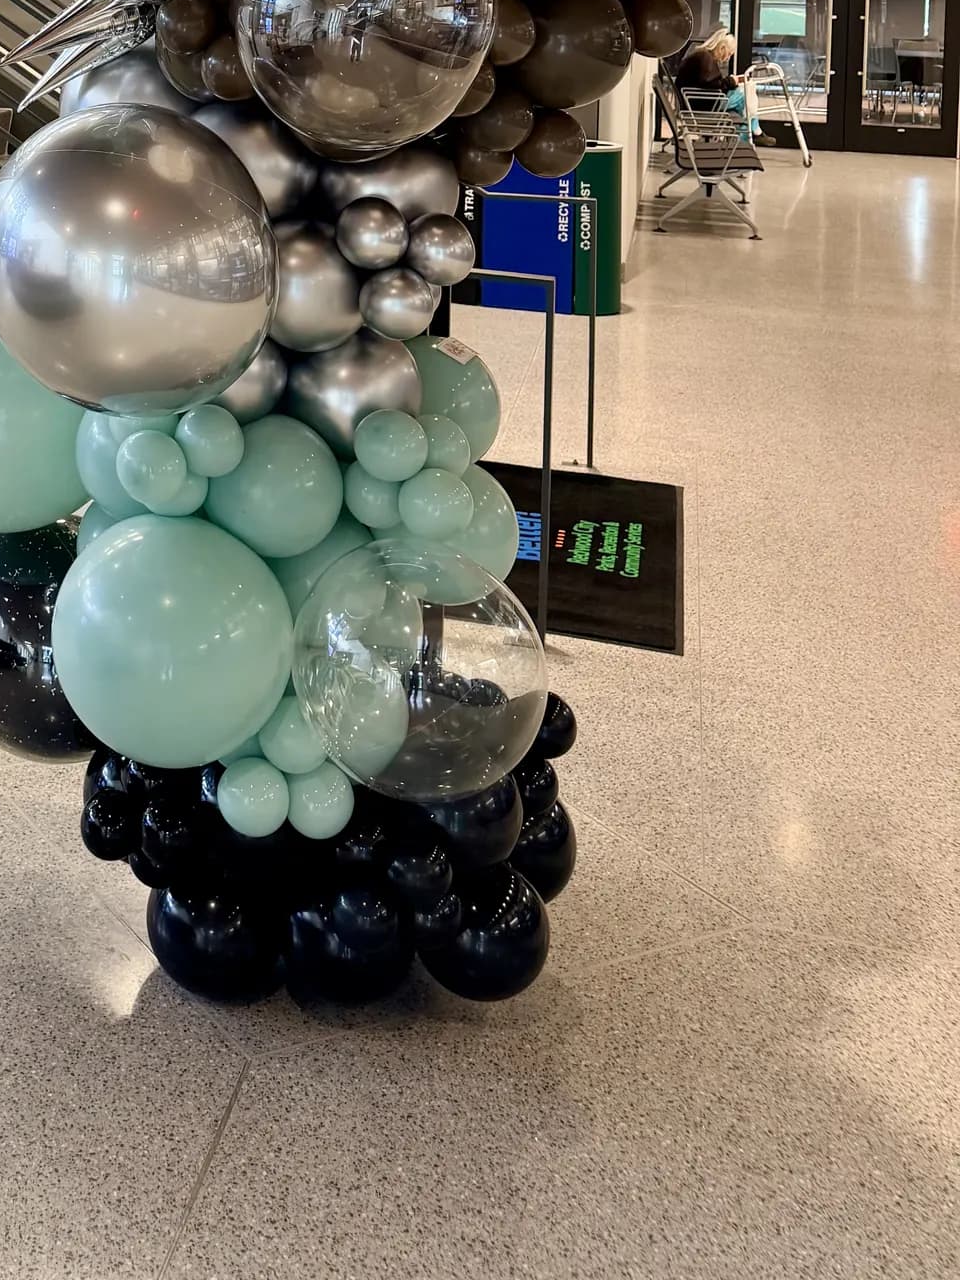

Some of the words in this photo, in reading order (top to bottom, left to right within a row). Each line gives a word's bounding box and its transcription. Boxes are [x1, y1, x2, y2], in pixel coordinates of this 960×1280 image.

[464, 185, 475, 211] TRA
[580, 181, 591, 239] COMPST
[571, 519, 600, 533] City
[598, 525, 620, 555] Recreation
[623, 522, 643, 545] Services
[566, 531, 593, 566] Redwood
[619, 543, 646, 578] Community
